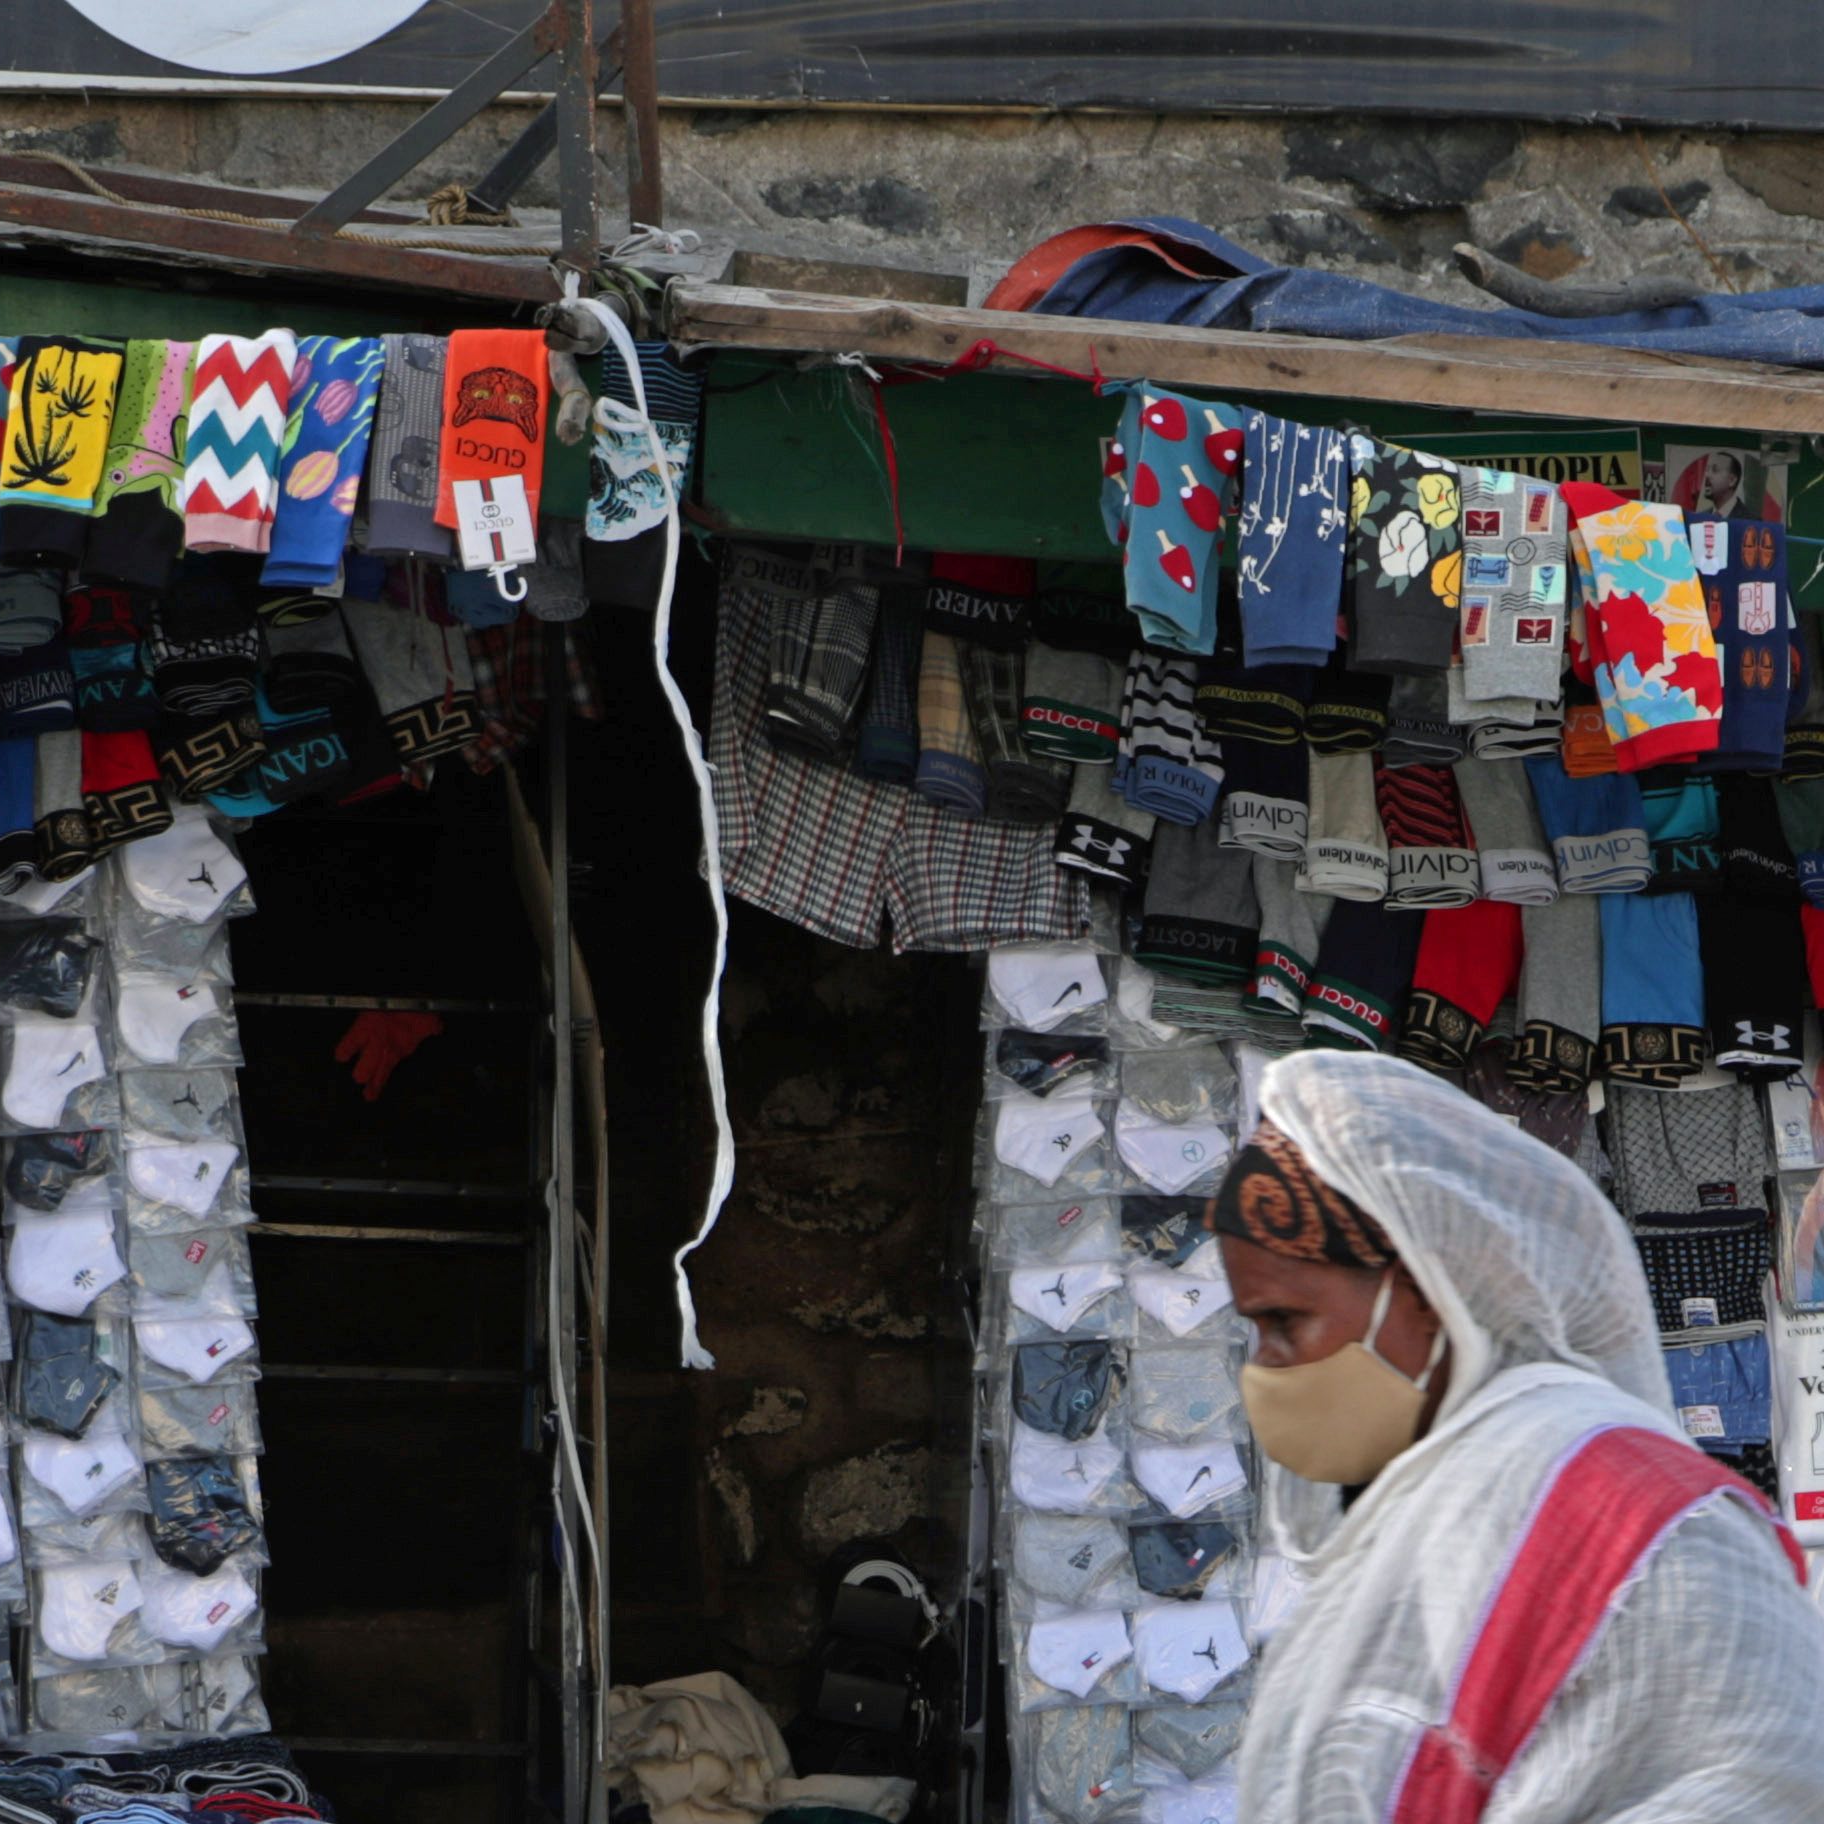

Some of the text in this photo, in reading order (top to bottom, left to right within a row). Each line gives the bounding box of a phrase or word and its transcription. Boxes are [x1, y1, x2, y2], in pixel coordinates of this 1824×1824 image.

[456, 437, 526, 469] GUCCI
[473, 517, 514, 531] GUCCI
[1028, 706, 1101, 734] GUCCI
[1163, 771, 1208, 798] POLO
[1318, 846, 1353, 864] Klein
[1324, 984, 1383, 1027] GUCCI
